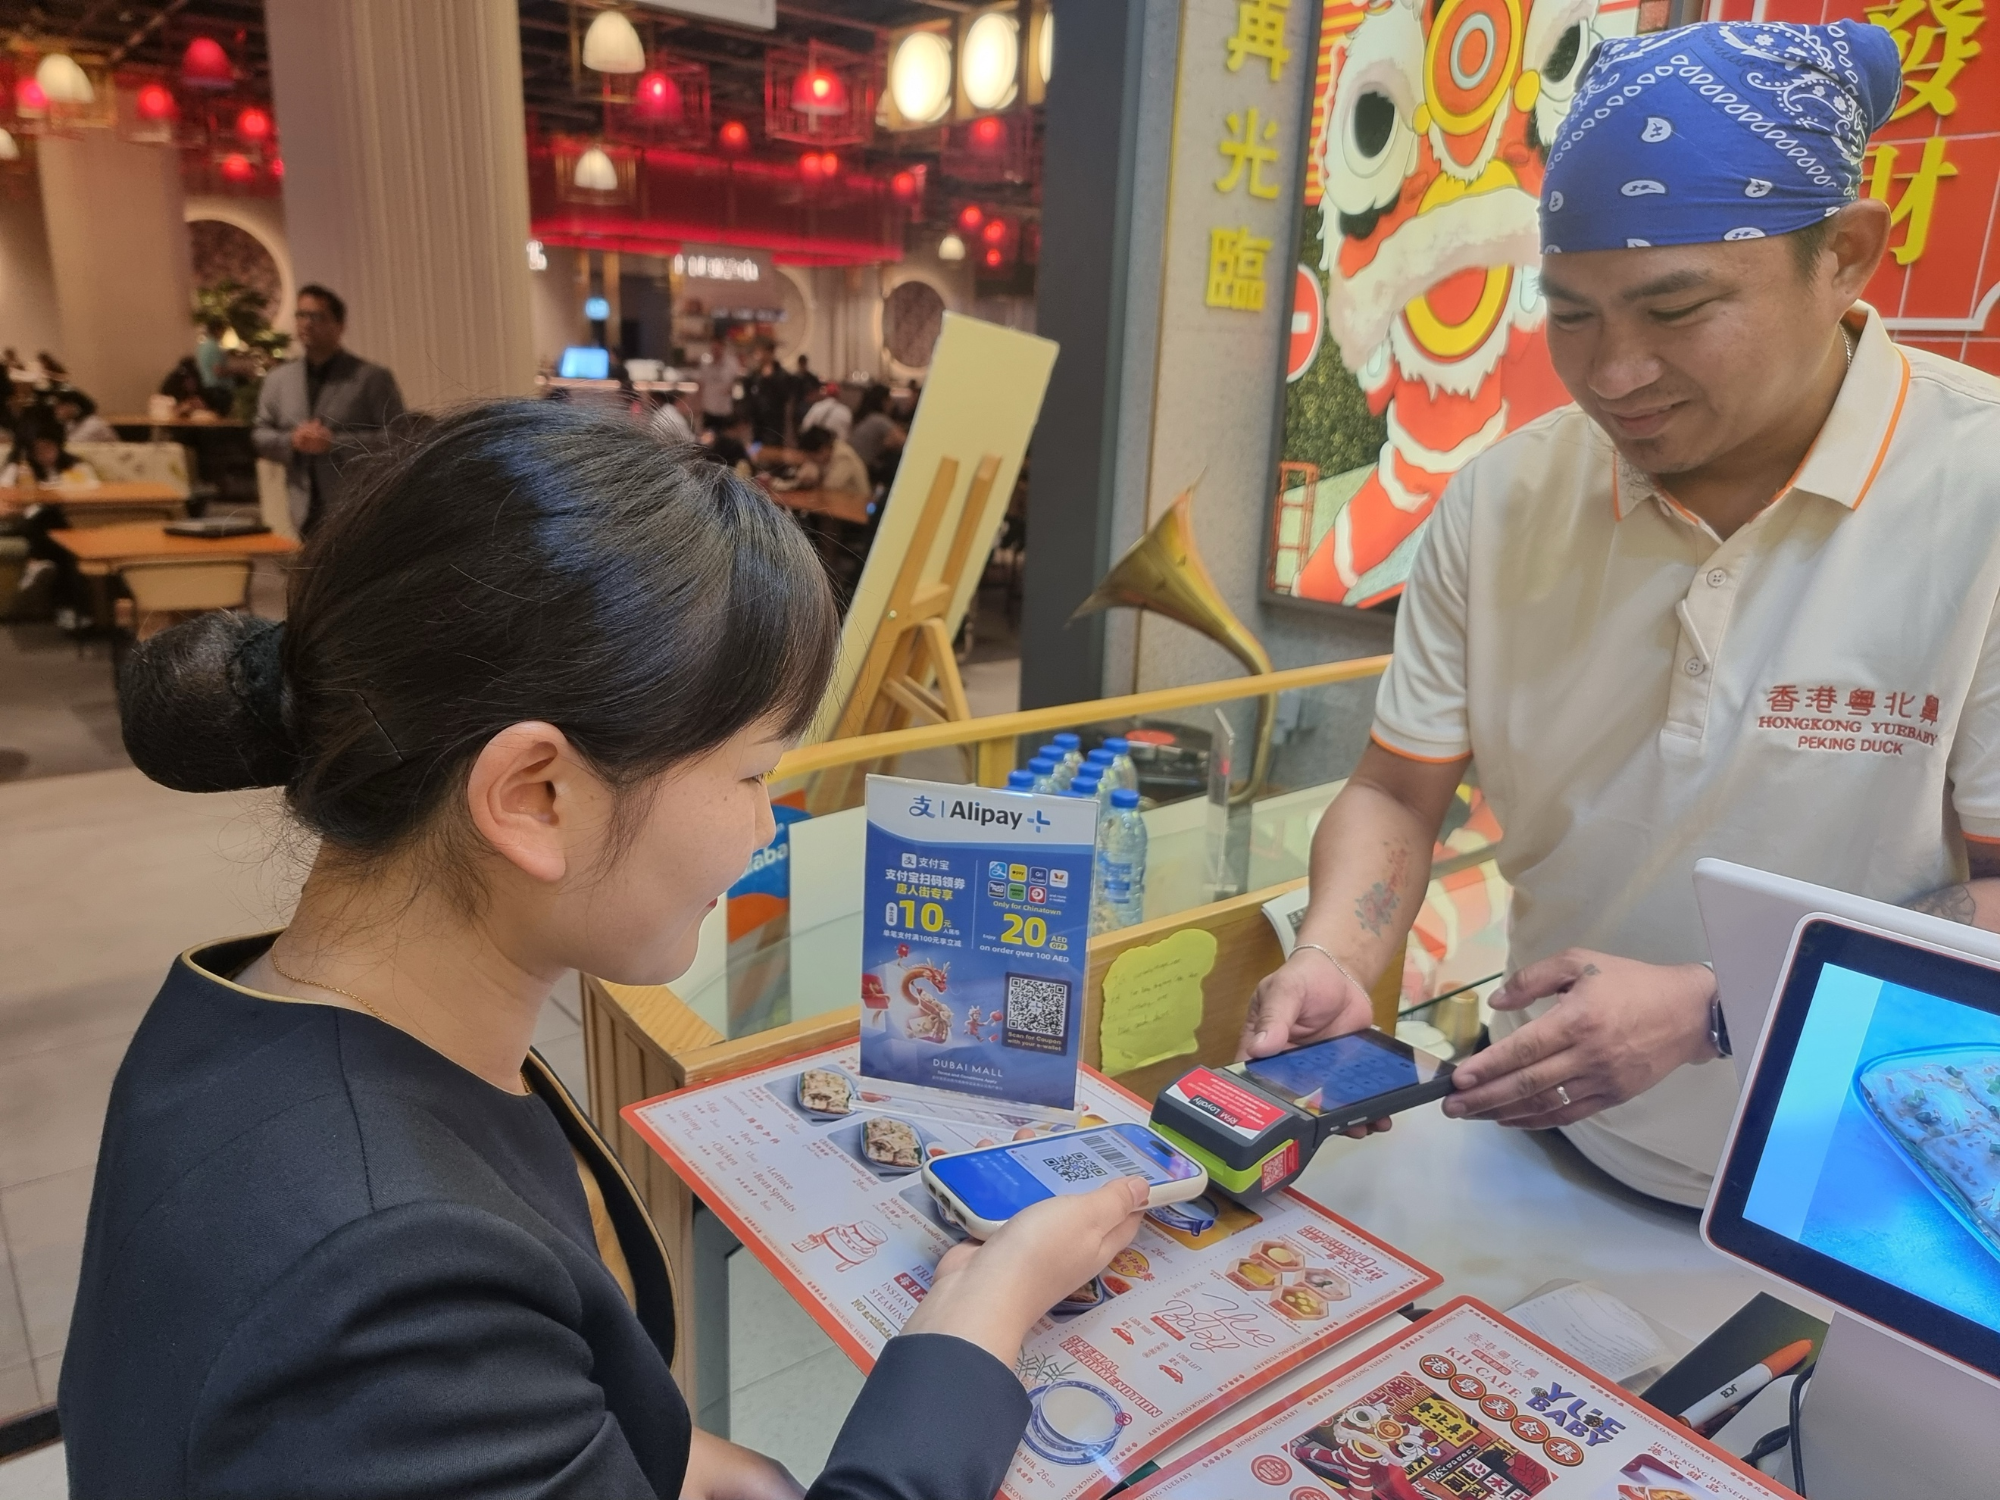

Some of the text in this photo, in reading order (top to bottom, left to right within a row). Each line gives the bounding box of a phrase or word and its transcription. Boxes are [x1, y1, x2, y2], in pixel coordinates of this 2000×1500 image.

[1758, 715, 1939, 747] HONGKONG YUEBABY
[1798, 735, 1904, 756] PEKING DUCK
[949, 799, 1024, 830] Alipay
[918, 857, 950, 871] 支付宝
[885, 868, 966, 890] 支付宝扫码领券
[895, 883, 954, 900] 唐人街专享
[899, 899, 944, 932] 10
[993, 901, 1010, 910] Only
[1023, 905, 1062, 916] Chinatown
[1001, 913, 1047, 948] 20
[1051, 935, 1068, 944] AED
[992, 946, 1014, 955] order
[1016, 950, 1034, 958] over
[1036, 952, 1051, 960] 100
[1052, 954, 1069, 963] AED
[1051, 942, 1066, 950] OFF
[1007, 1031, 1024, 1039] Scan
[1036, 1035, 1062, 1046] Coupon
[1036, 1043, 1062, 1052] e-wallet
[932, 1058, 1004, 1078] DUBAI MALL
[1192, 1096, 1221, 1116] Loyalty
[1221, 1110, 1239, 1126] RFM
[1145, 1222, 1175, 1245] Steamed
[881, 1281, 916, 1312] INSTANT
[862, 1310, 899, 1342] artificia
[1067, 1333, 1121, 1376] SPECIAL
[1503, 1330, 1545, 1359] HONGKONG
[1545, 1357, 1579, 1379] YUEBABY
[1336, 1366, 1370, 1389] HONGKONG
[1444, 1346, 1523, 1399] KH.CAFE
[1719, 1383, 1738, 1399] JCB
[1525, 1393, 1610, 1447] BABY
[1235, 1425, 1272, 1449] HONGKONG
[1630, 1409, 1717, 1464] HONGKONG YUEBABY
[1020, 1455, 1037, 1471] Milk
[1652, 1441, 1682, 1460] HONG
[1680, 1457, 1709, 1478] KONG
[1036, 1468, 1056, 1489] 26AED
